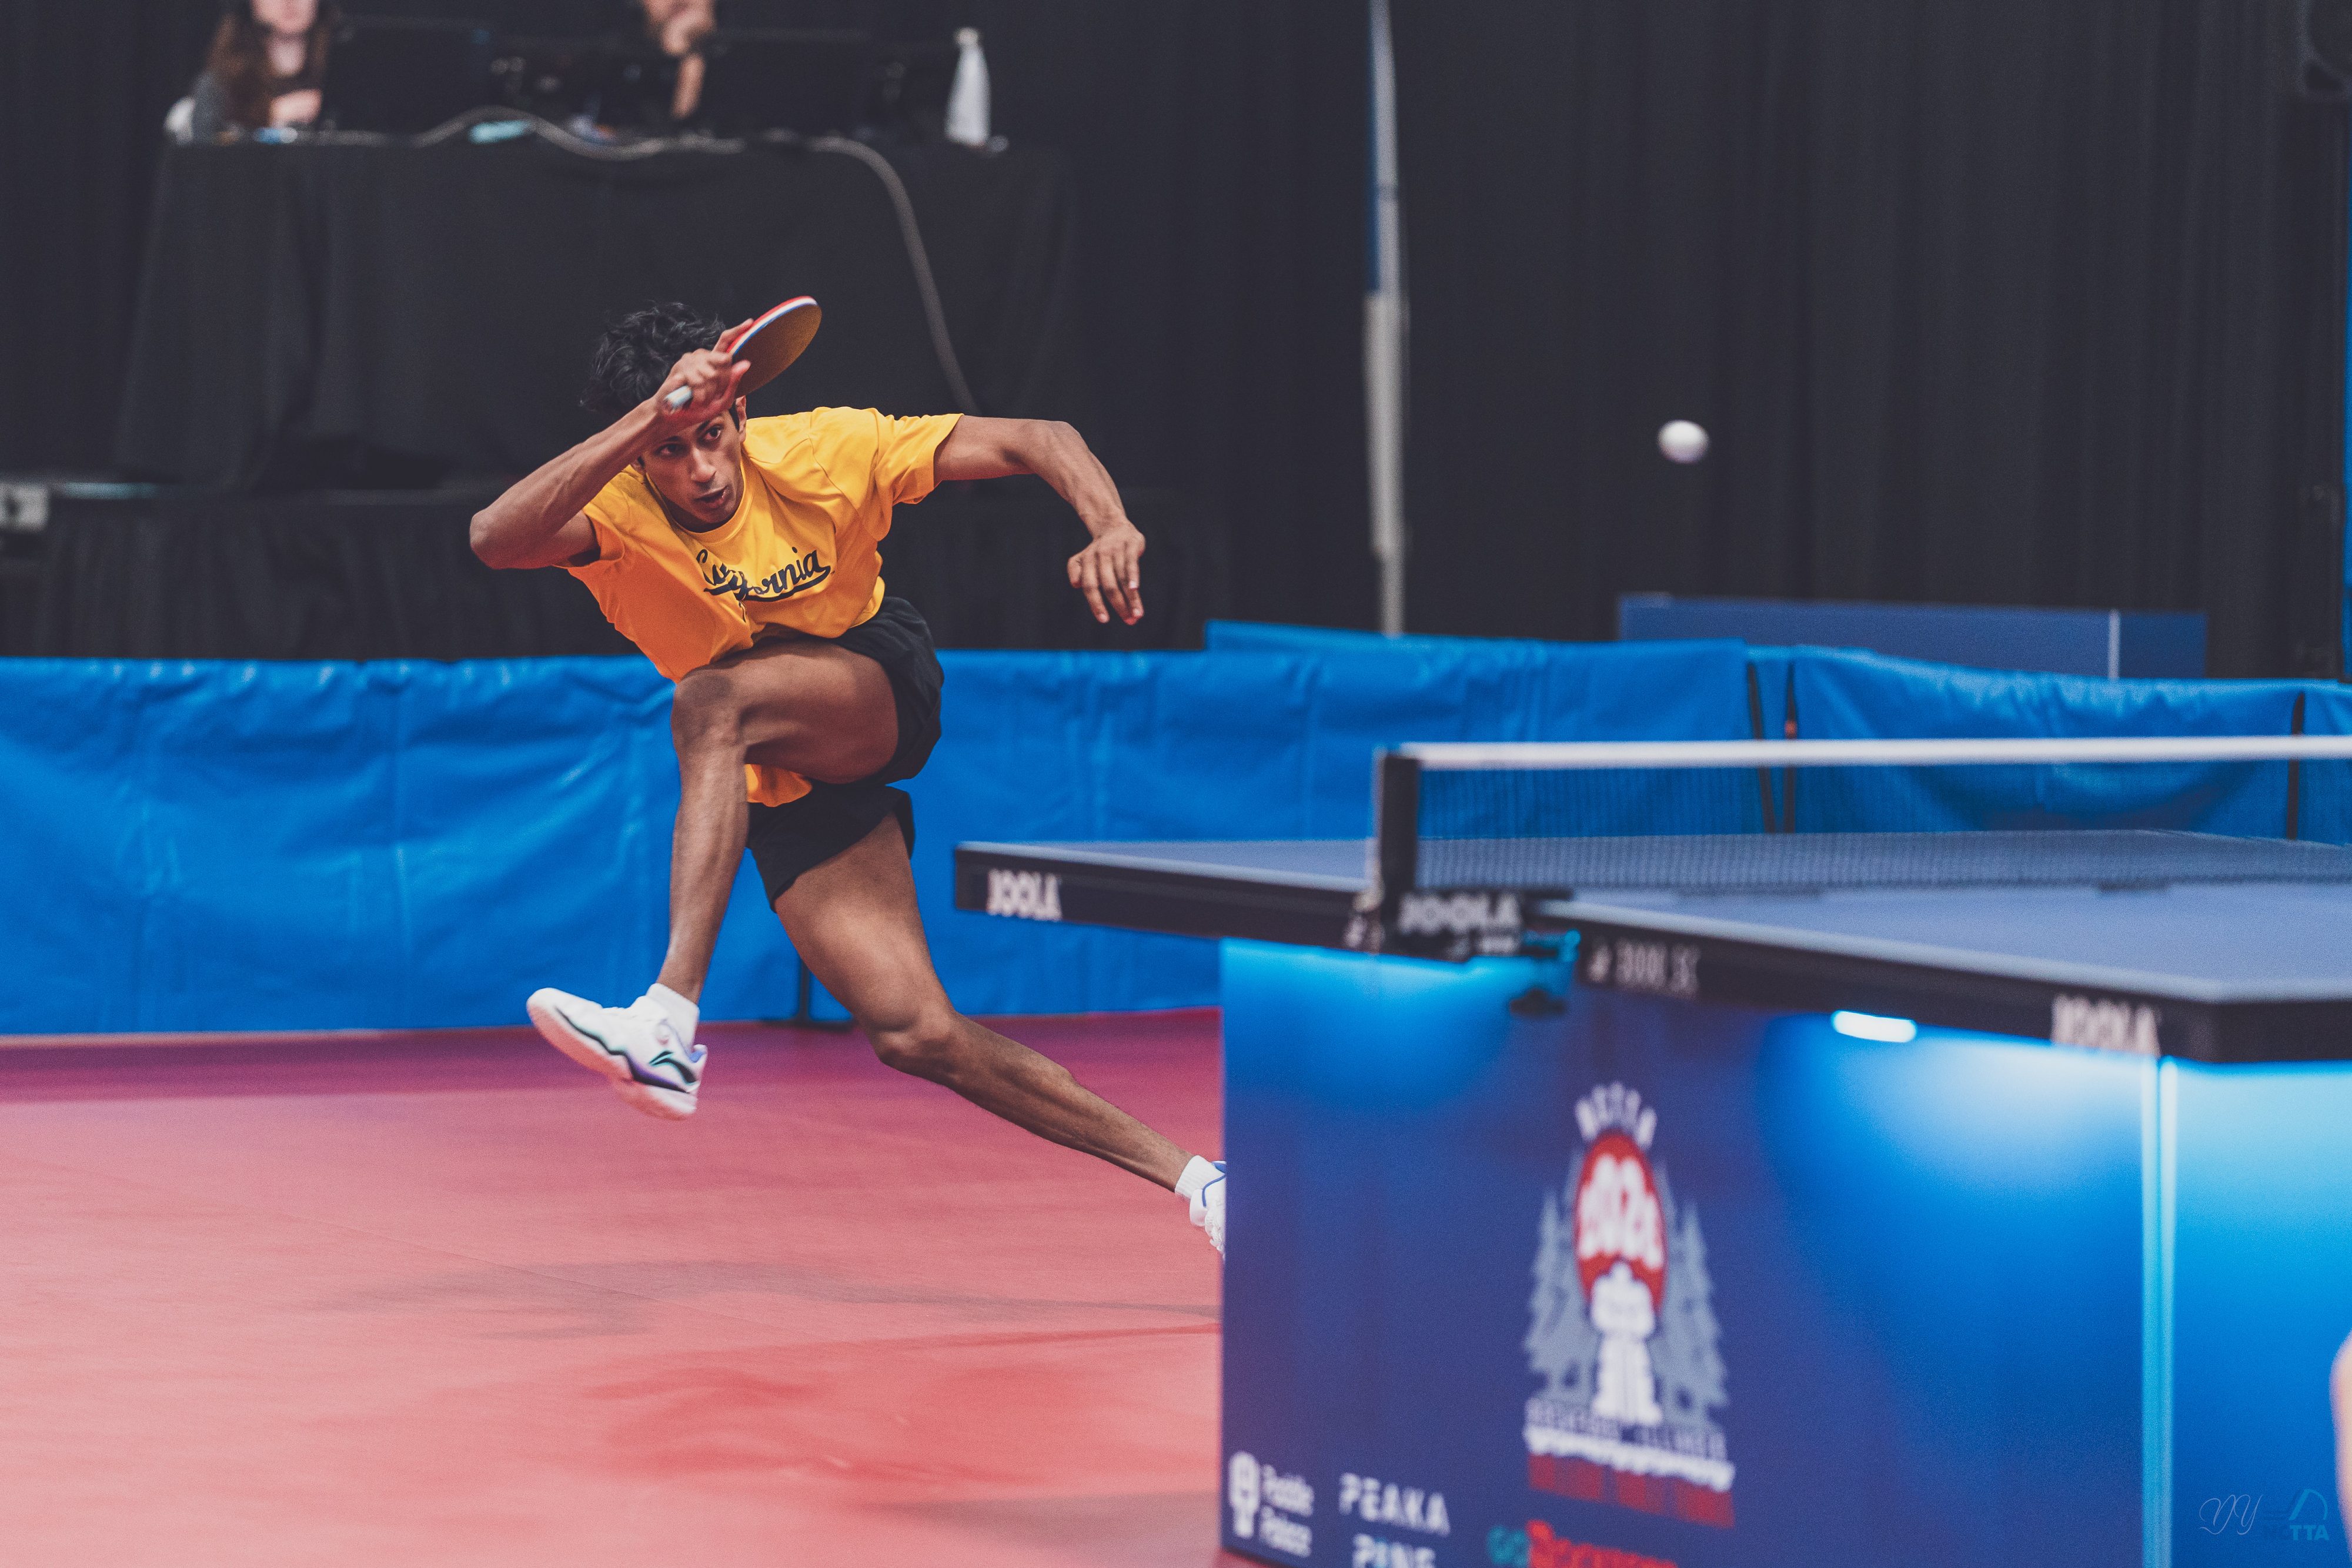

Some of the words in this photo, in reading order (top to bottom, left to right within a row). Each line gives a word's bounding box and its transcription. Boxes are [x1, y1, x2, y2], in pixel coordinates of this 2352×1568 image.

[987, 868, 1063, 921] JOOLA
[1398, 893, 1523, 935] JOOLA
[1339, 1472, 1451, 1537] PEAKA
